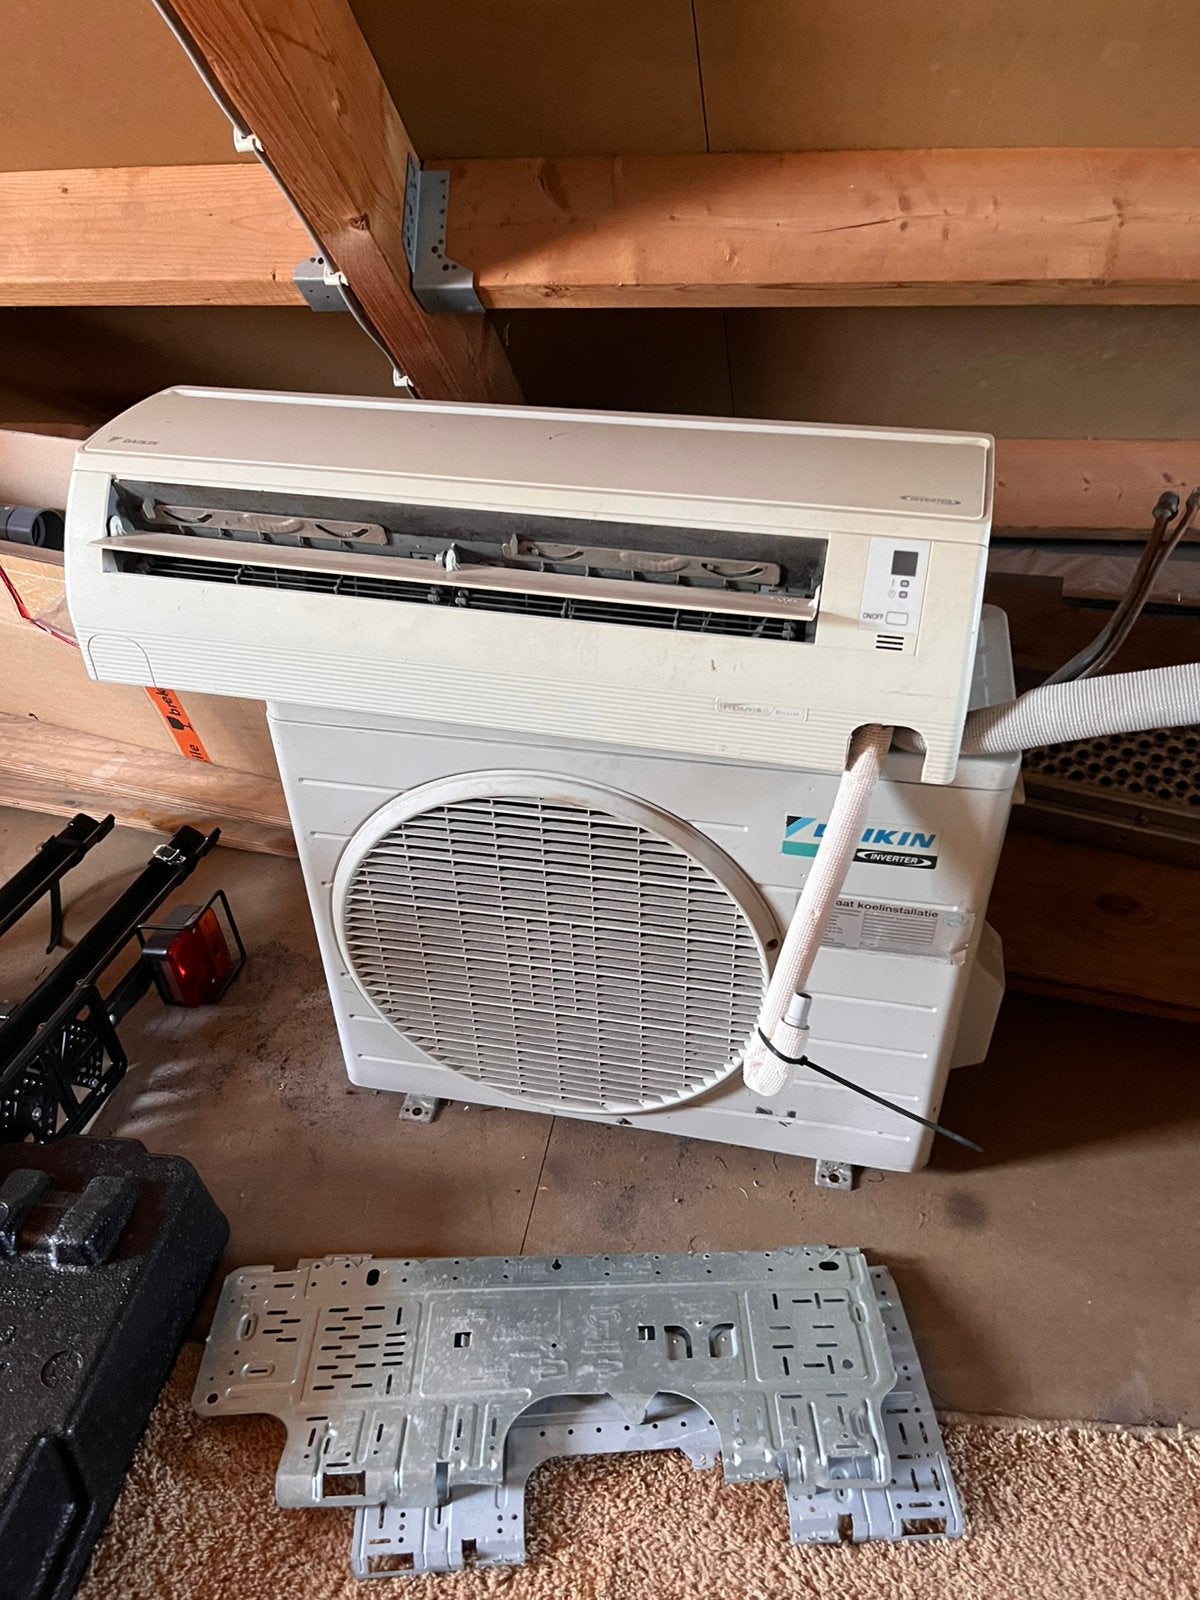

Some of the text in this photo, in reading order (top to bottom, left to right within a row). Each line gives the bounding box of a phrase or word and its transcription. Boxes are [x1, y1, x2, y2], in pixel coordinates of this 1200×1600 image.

[813, 823, 936, 848] IKIN
[870, 853, 918, 864] INVERTER
[857, 901, 939, 919] koelinstallatie
